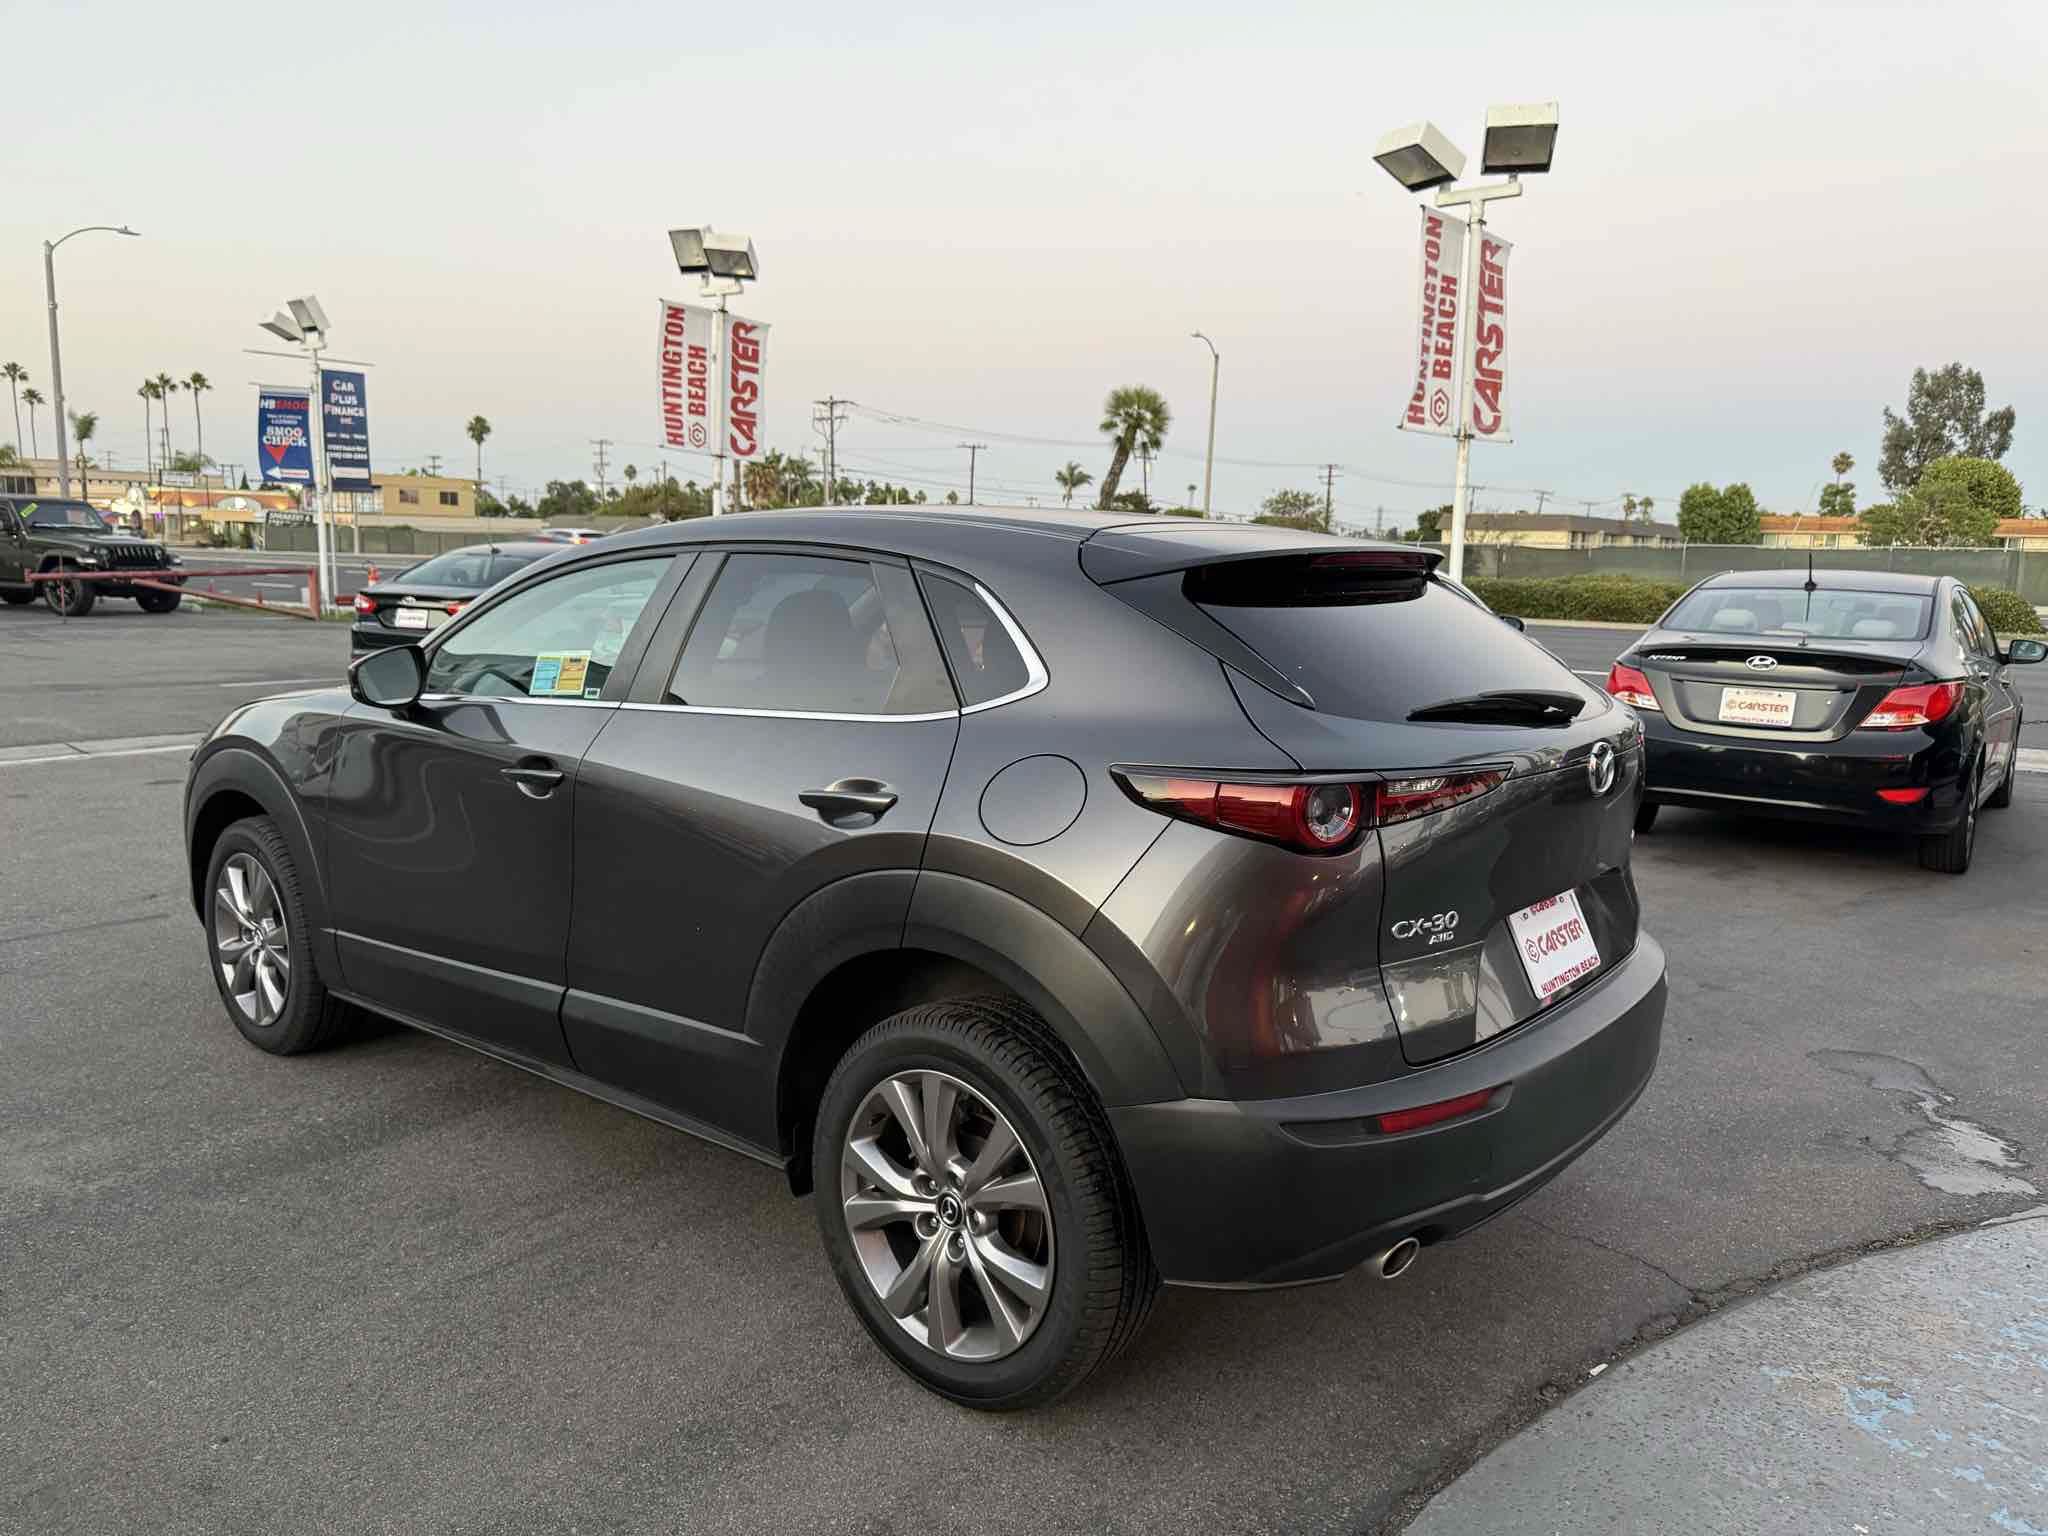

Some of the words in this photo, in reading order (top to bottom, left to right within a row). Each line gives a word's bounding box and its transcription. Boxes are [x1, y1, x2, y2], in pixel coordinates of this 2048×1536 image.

[1407, 215, 1443, 426] HUNTINGTON
[1432, 273, 1458, 381] BEACH
[1473, 238, 1504, 435] CARSTER
[332, 380, 355, 393] CAR
[662, 305, 686, 447] HUNTINGTON
[687, 343, 708, 417] BEACH
[730, 320, 760, 457] CARSTER
[323, 404, 365, 417] FINANCE
[330, 392, 358, 406] PLUS
[262, 435, 308, 447] CHECK
[1391, 910, 1459, 939] CX-30
[1537, 917, 1585, 956] CARSTER
[1540, 964, 1581, 996] HUNTINGTON
[1580, 955, 1600, 973] BEACH
